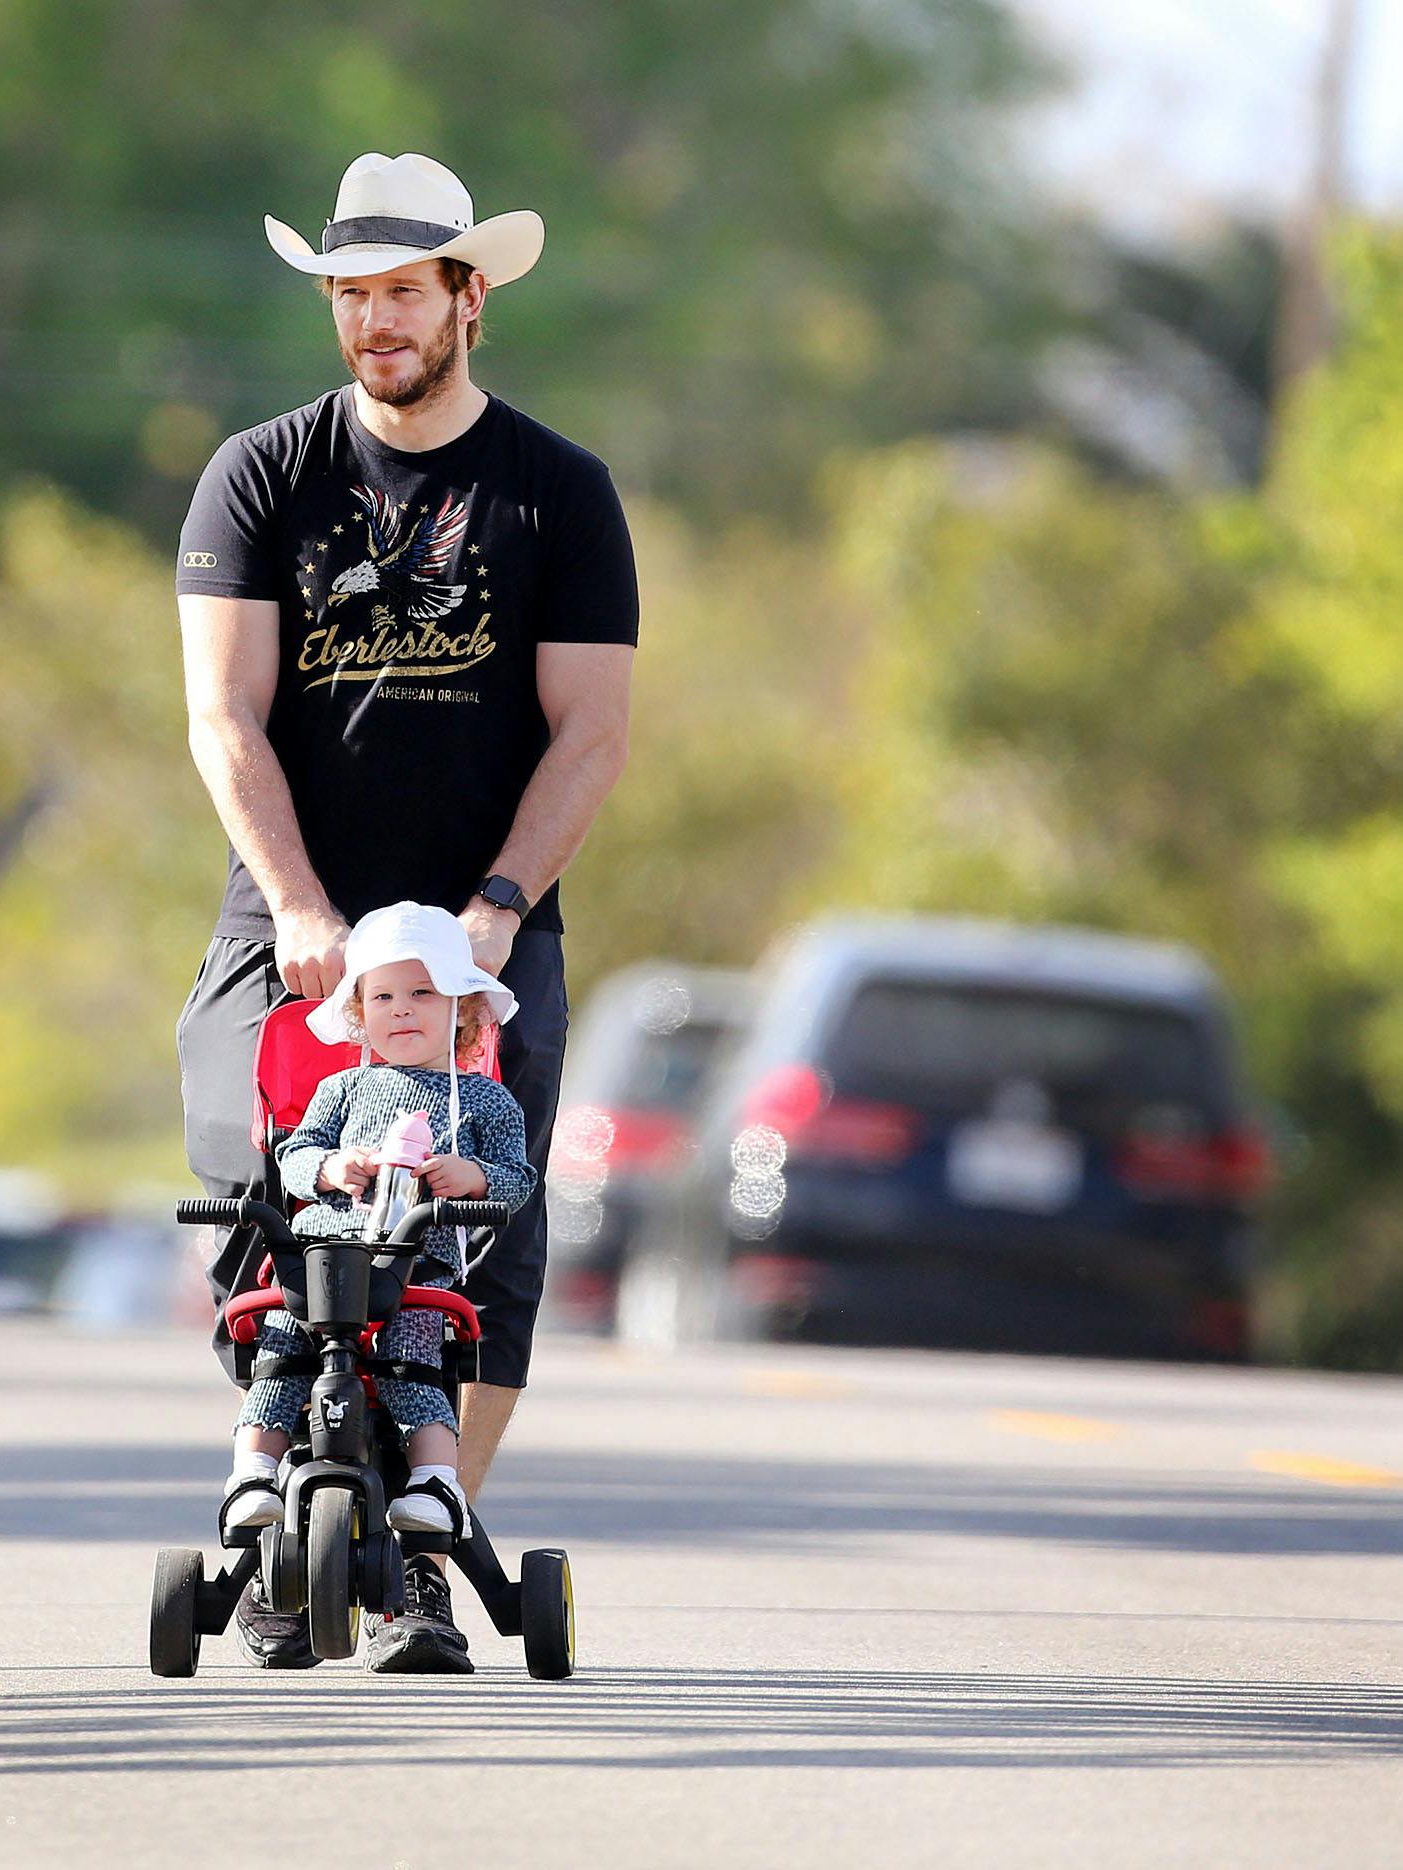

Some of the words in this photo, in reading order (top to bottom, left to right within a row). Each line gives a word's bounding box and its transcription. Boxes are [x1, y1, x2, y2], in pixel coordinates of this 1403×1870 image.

[298, 613, 496, 671] Eberlestock
[377, 686, 434, 701] AMERICAN
[438, 689, 480, 703] ORIGINAL
